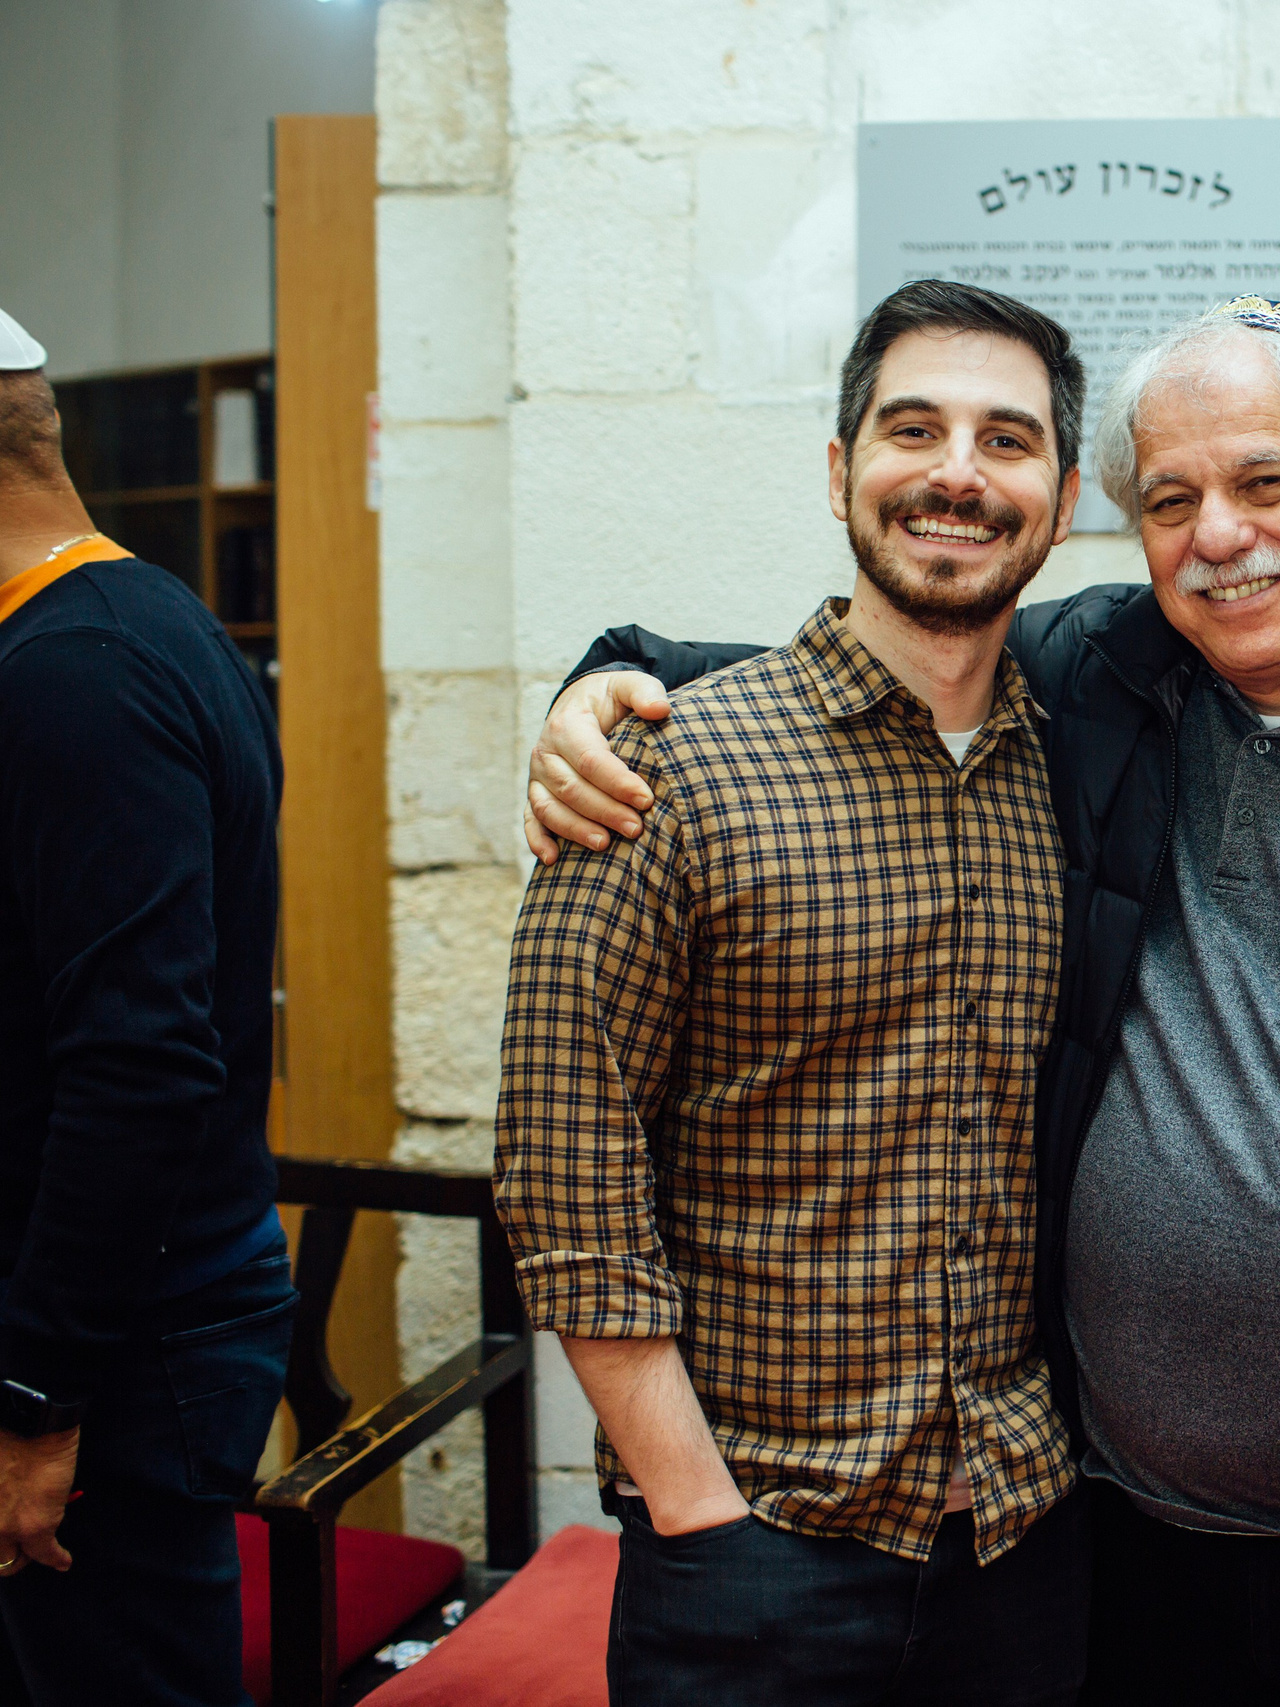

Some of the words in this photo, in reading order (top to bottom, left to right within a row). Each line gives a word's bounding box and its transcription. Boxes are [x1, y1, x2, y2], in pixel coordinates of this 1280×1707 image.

[977, 163, 1077, 215] עולם
[1099, 161, 1233, 209] לזכרון
[950, 262, 1011, 283] אלעזר
[1022, 264, 1071, 283] יעקב
[1154, 260, 1217, 281] אלעזר
